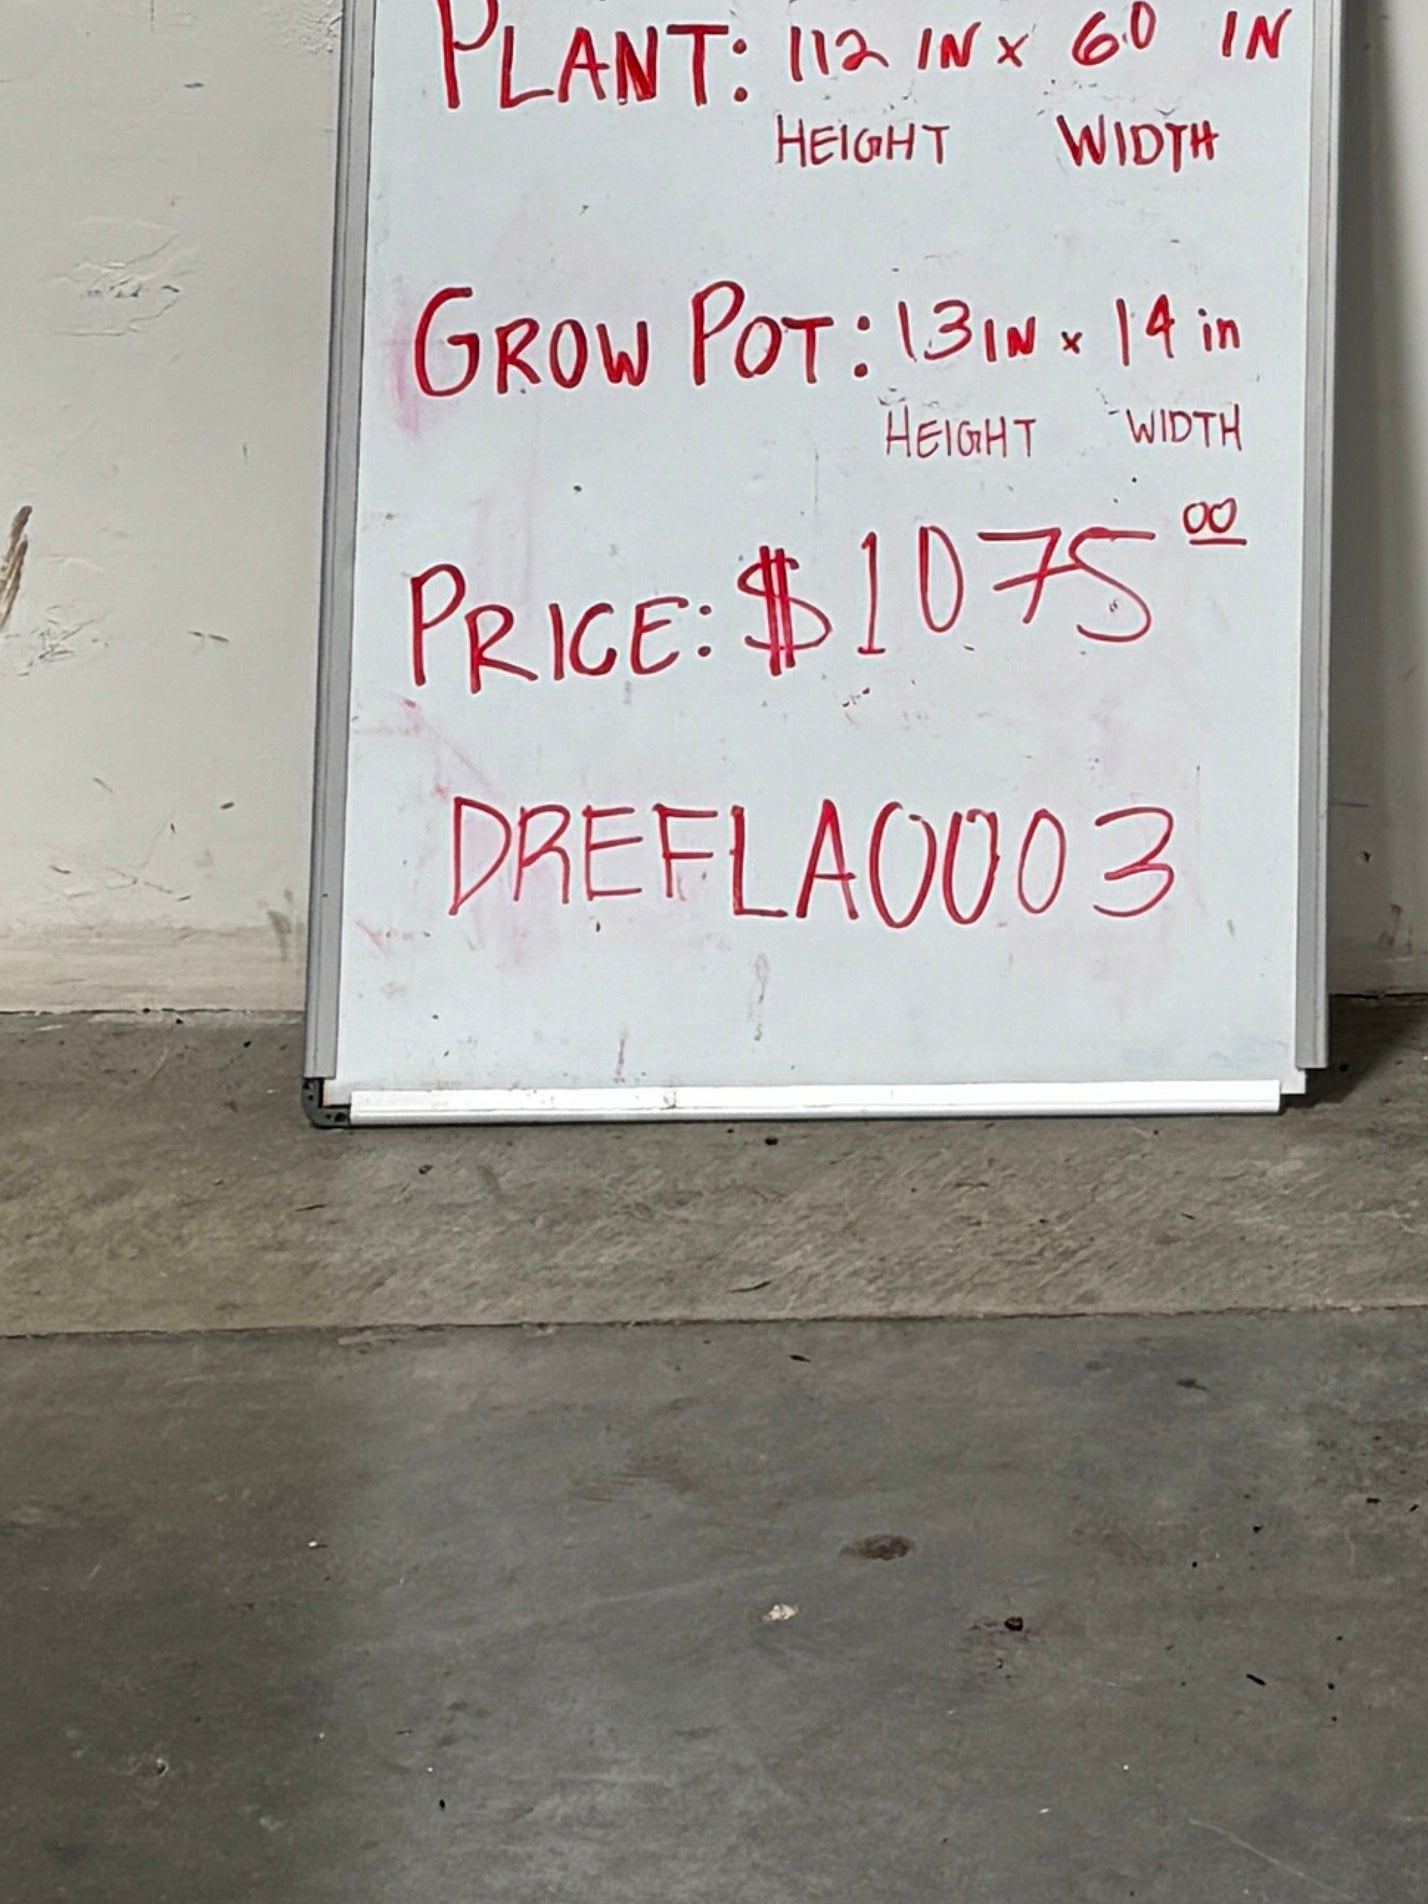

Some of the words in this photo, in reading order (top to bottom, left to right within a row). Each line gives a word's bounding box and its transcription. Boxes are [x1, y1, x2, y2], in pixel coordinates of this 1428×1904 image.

[788, 25, 889, 83] 112
[916, 21, 981, 71] IN
[1070, 0, 1157, 68] 60
[1220, 8, 1292, 61] IN
[776, 114, 947, 168] HEIGHT
[1055, 114, 1219, 174] WIDTH
[412, 286, 650, 399] GROW
[690, 280, 871, 387] POT:
[1115, 293, 1176, 367] 14
[1200, 307, 1242, 353] in
[885, 404, 1037, 459] HEIGHT
[1125, 402, 1243, 452] WIDTH
[409, 563, 711, 695] PRICE:
[448, 795, 1176, 930] DREFLA0003
